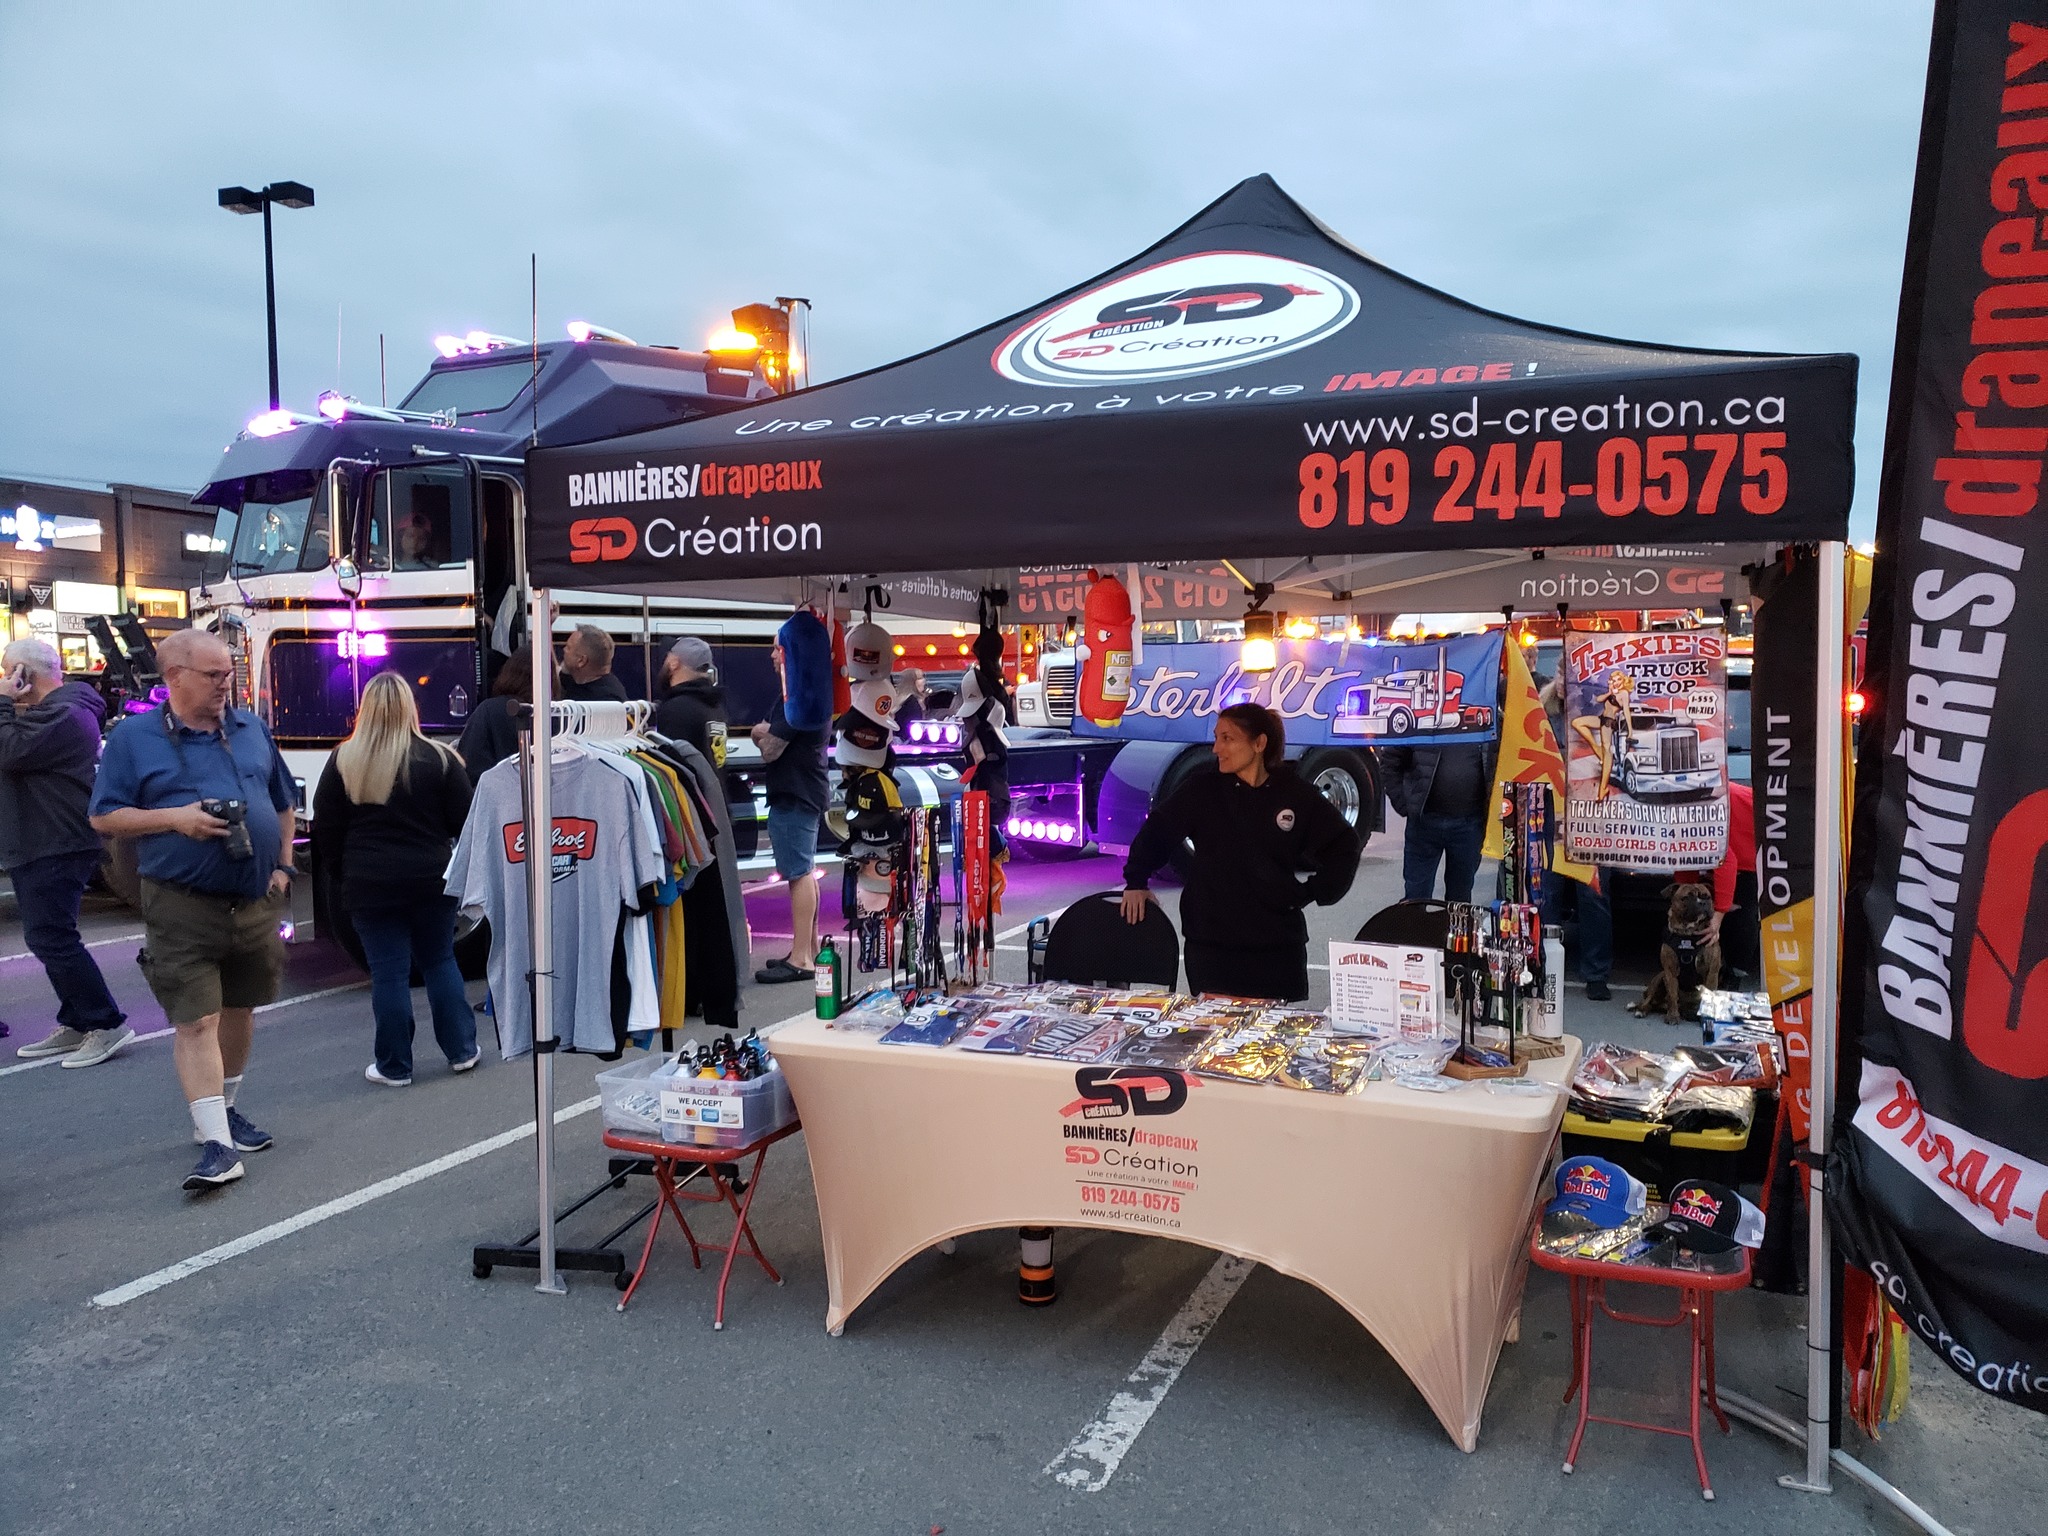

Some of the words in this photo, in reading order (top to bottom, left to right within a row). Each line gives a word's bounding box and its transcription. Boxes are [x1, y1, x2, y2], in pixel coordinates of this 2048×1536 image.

[1097, 282, 1295, 326] SD
[1092, 319, 1165, 338] CRÉATION
[1052, 344, 1116, 361] SD
[1119, 334, 1280, 354] Création
[735, 418, 834, 436] Une
[850, 399, 1075, 430] création
[1095, 394, 1133, 409] à
[1156, 383, 1306, 405] votre
[1323, 363, 1514, 393] IMAGE
[1303, 394, 1786, 447] www.sd-creation.ca
[1299, 449, 1410, 529] 819
[1432, 431, 1788, 522] 244-0575
[569, 517, 638, 563] SD
[645, 515, 822, 558] Création
[1570, 634, 1724, 683] TRIXIE'S
[1626, 660, 1709, 679] TRUCK
[1637, 678, 1697, 695] STOP
[1570, 799, 1633, 819] TRUCKERS
[1634, 804, 1668, 824] DRIVE
[1669, 803, 1727, 825] AMERICA
[1570, 821, 1600, 834] FULL
[1605, 823, 1657, 837] SERVICE
[1660, 828, 1677, 839] 24
[1681, 825, 1725, 838] HOURS
[1573, 836, 1613, 848] ROAD
[1615, 838, 1657, 852] GIRLS
[1659, 840, 1719, 853] GARAGE
[1593, 852, 1632, 863] PROBLEM
[1633, 855, 1650, 864] TOO
[1651, 856, 1667, 865] BIG
[1667, 857, 1678, 865] TO
[678, 1096, 690, 1105] WE
[691, 1098, 724, 1108] ACCEPT
[1074, 1066, 1188, 1117] SD
[666, 1107, 680, 1115] VISA
[1084, 1104, 1123, 1118] CRÉATION
[1065, 1145, 1101, 1165] SD
[1103, 1148, 1199, 1178] Création
[1087, 1169, 1104, 1178] Une
[1105, 1170, 1139, 1182] création
[1147, 1177, 1169, 1186] votre
[1081, 1186, 1106, 1203] 819
[1109, 1188, 1181, 1214] 244-0575
[1080, 1207, 1182, 1229] www.sd-creation.ca
